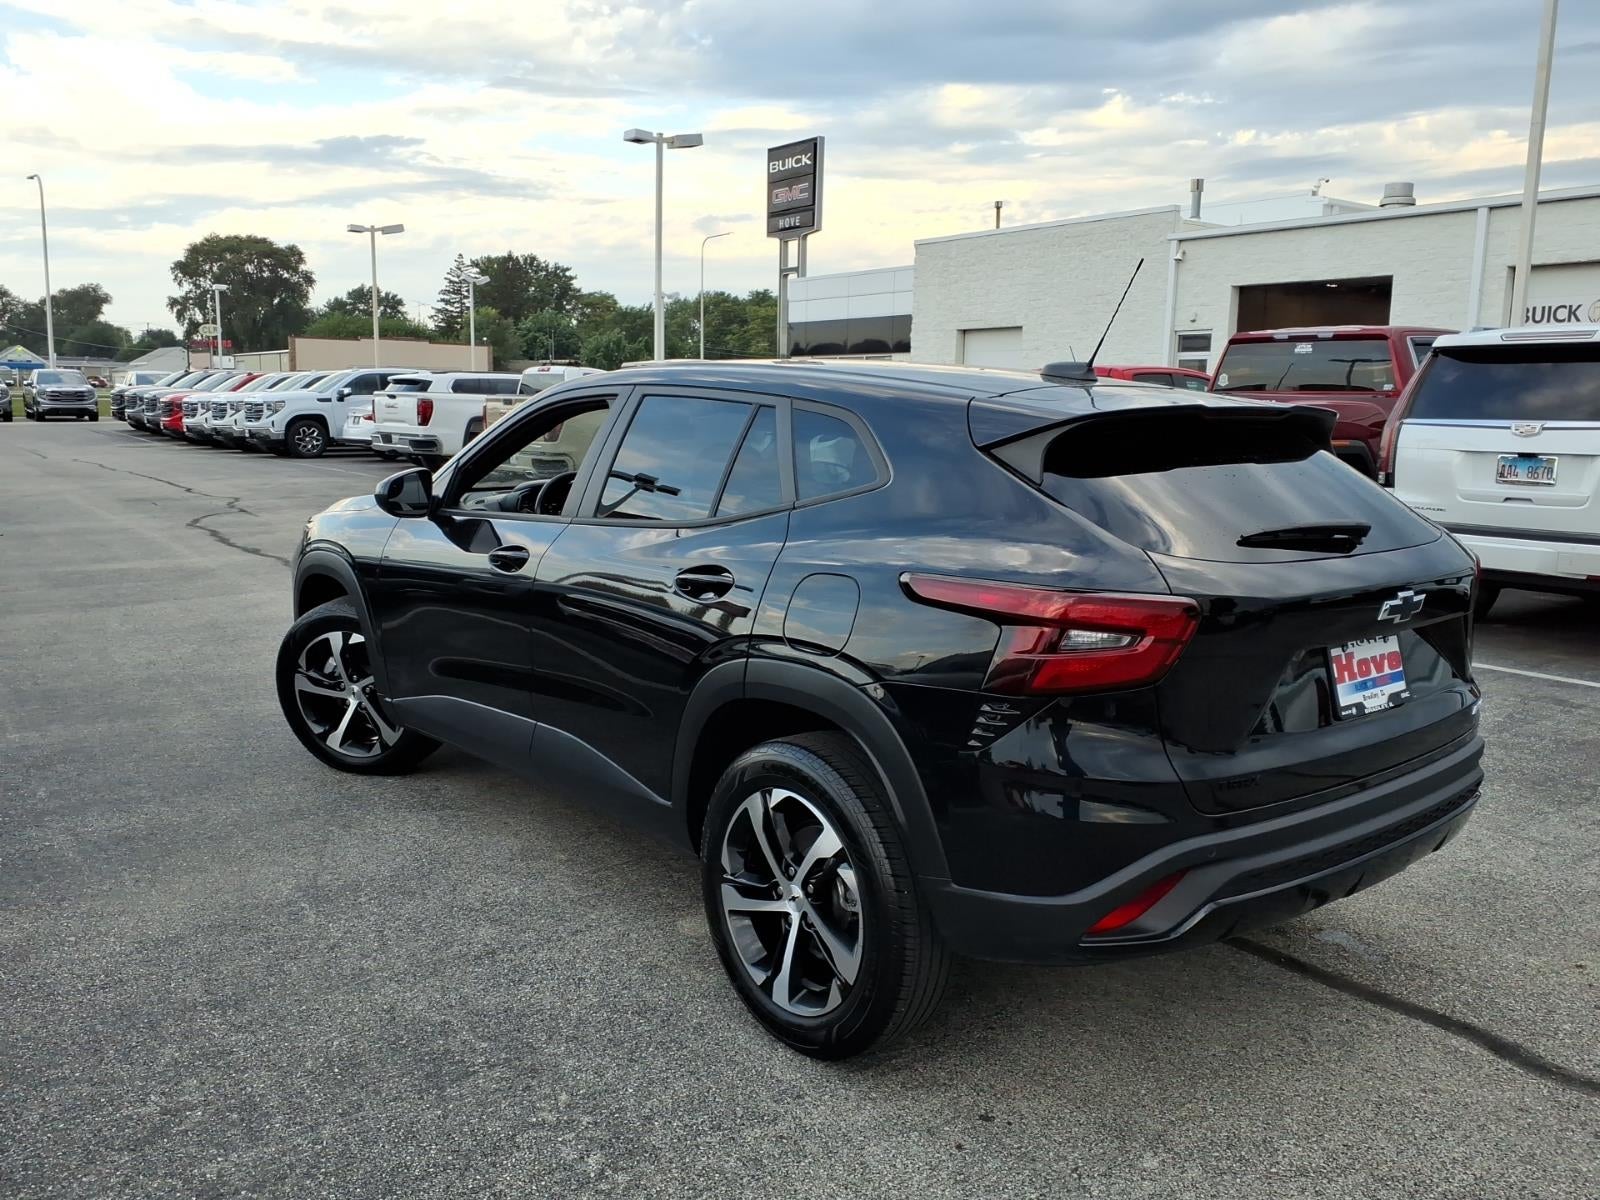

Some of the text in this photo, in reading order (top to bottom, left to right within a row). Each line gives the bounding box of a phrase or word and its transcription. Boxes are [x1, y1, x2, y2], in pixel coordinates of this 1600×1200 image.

[769, 152, 812, 173] BUICK
[772, 182, 809, 204] GMC
[779, 216, 800, 228] HOVE
